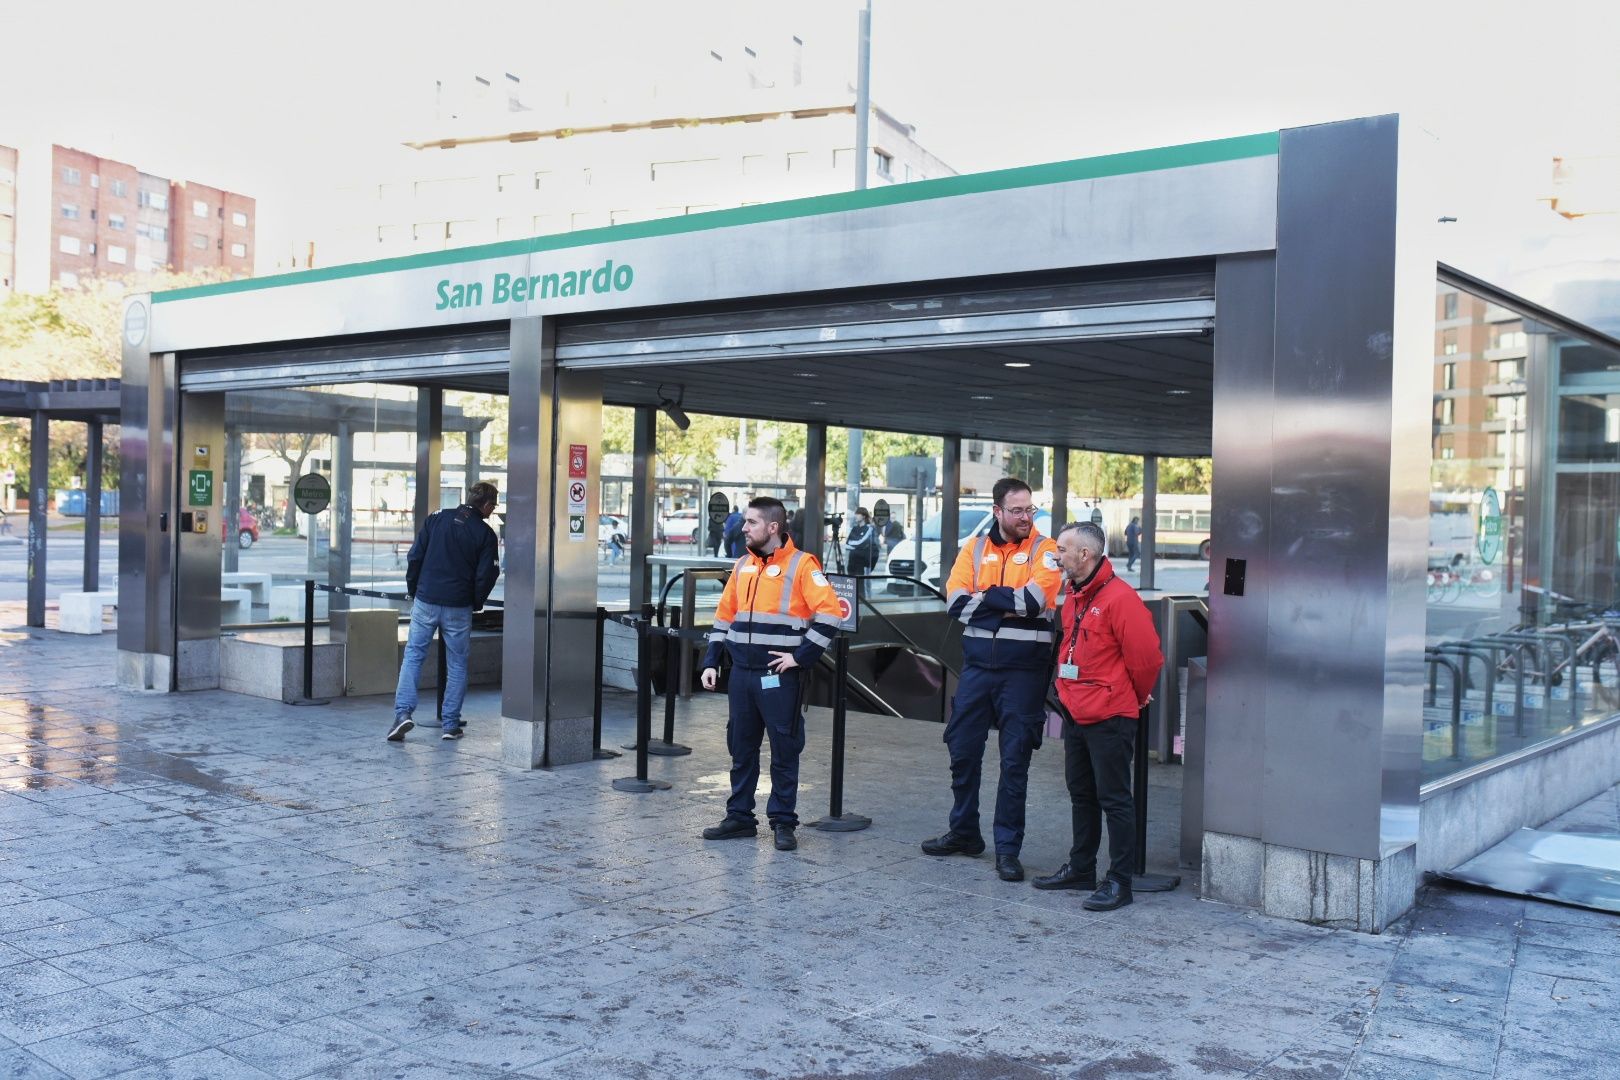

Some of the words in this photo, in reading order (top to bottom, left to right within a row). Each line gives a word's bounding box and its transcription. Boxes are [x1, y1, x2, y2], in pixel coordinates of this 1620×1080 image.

[436, 279, 483, 310] San
[492, 260, 634, 305] Bernardo
[302, 488, 323, 498] Metro
[846, 582, 854, 590] de
